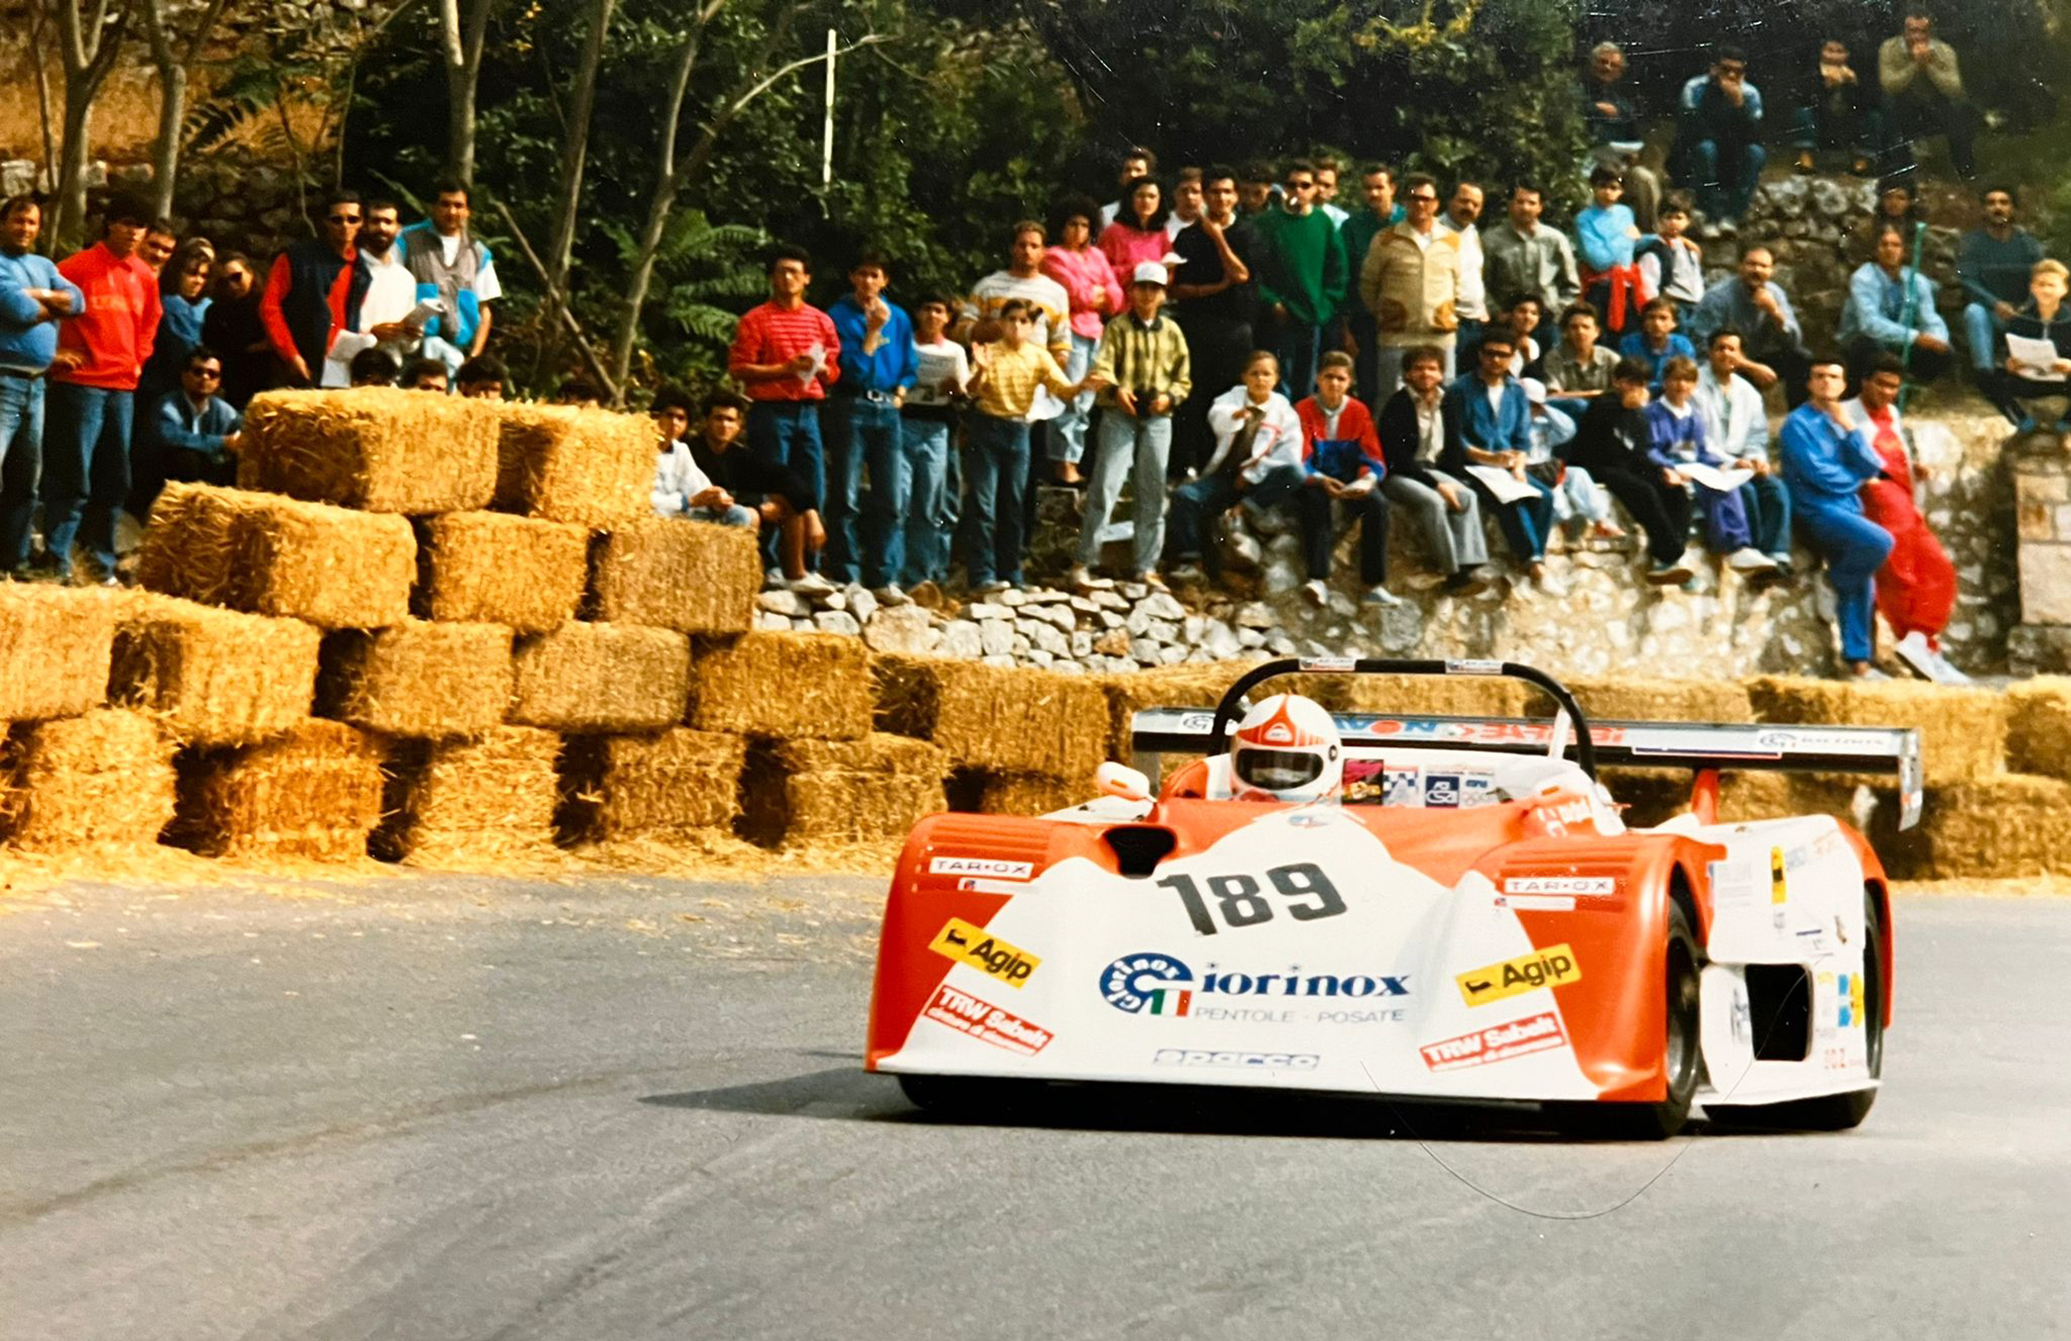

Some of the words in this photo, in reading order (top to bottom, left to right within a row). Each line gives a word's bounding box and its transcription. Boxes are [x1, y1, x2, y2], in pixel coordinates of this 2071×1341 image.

[1156, 862, 1348, 937] 189
[969, 938, 1032, 980] Agip
[1503, 955, 1572, 988] Agip
[939, 987, 992, 1020] TRW
[1196, 1006, 1296, 1022] PENTOLE
[1318, 1008, 1409, 1023] POSATE
[1424, 1033, 1482, 1062] TRW
